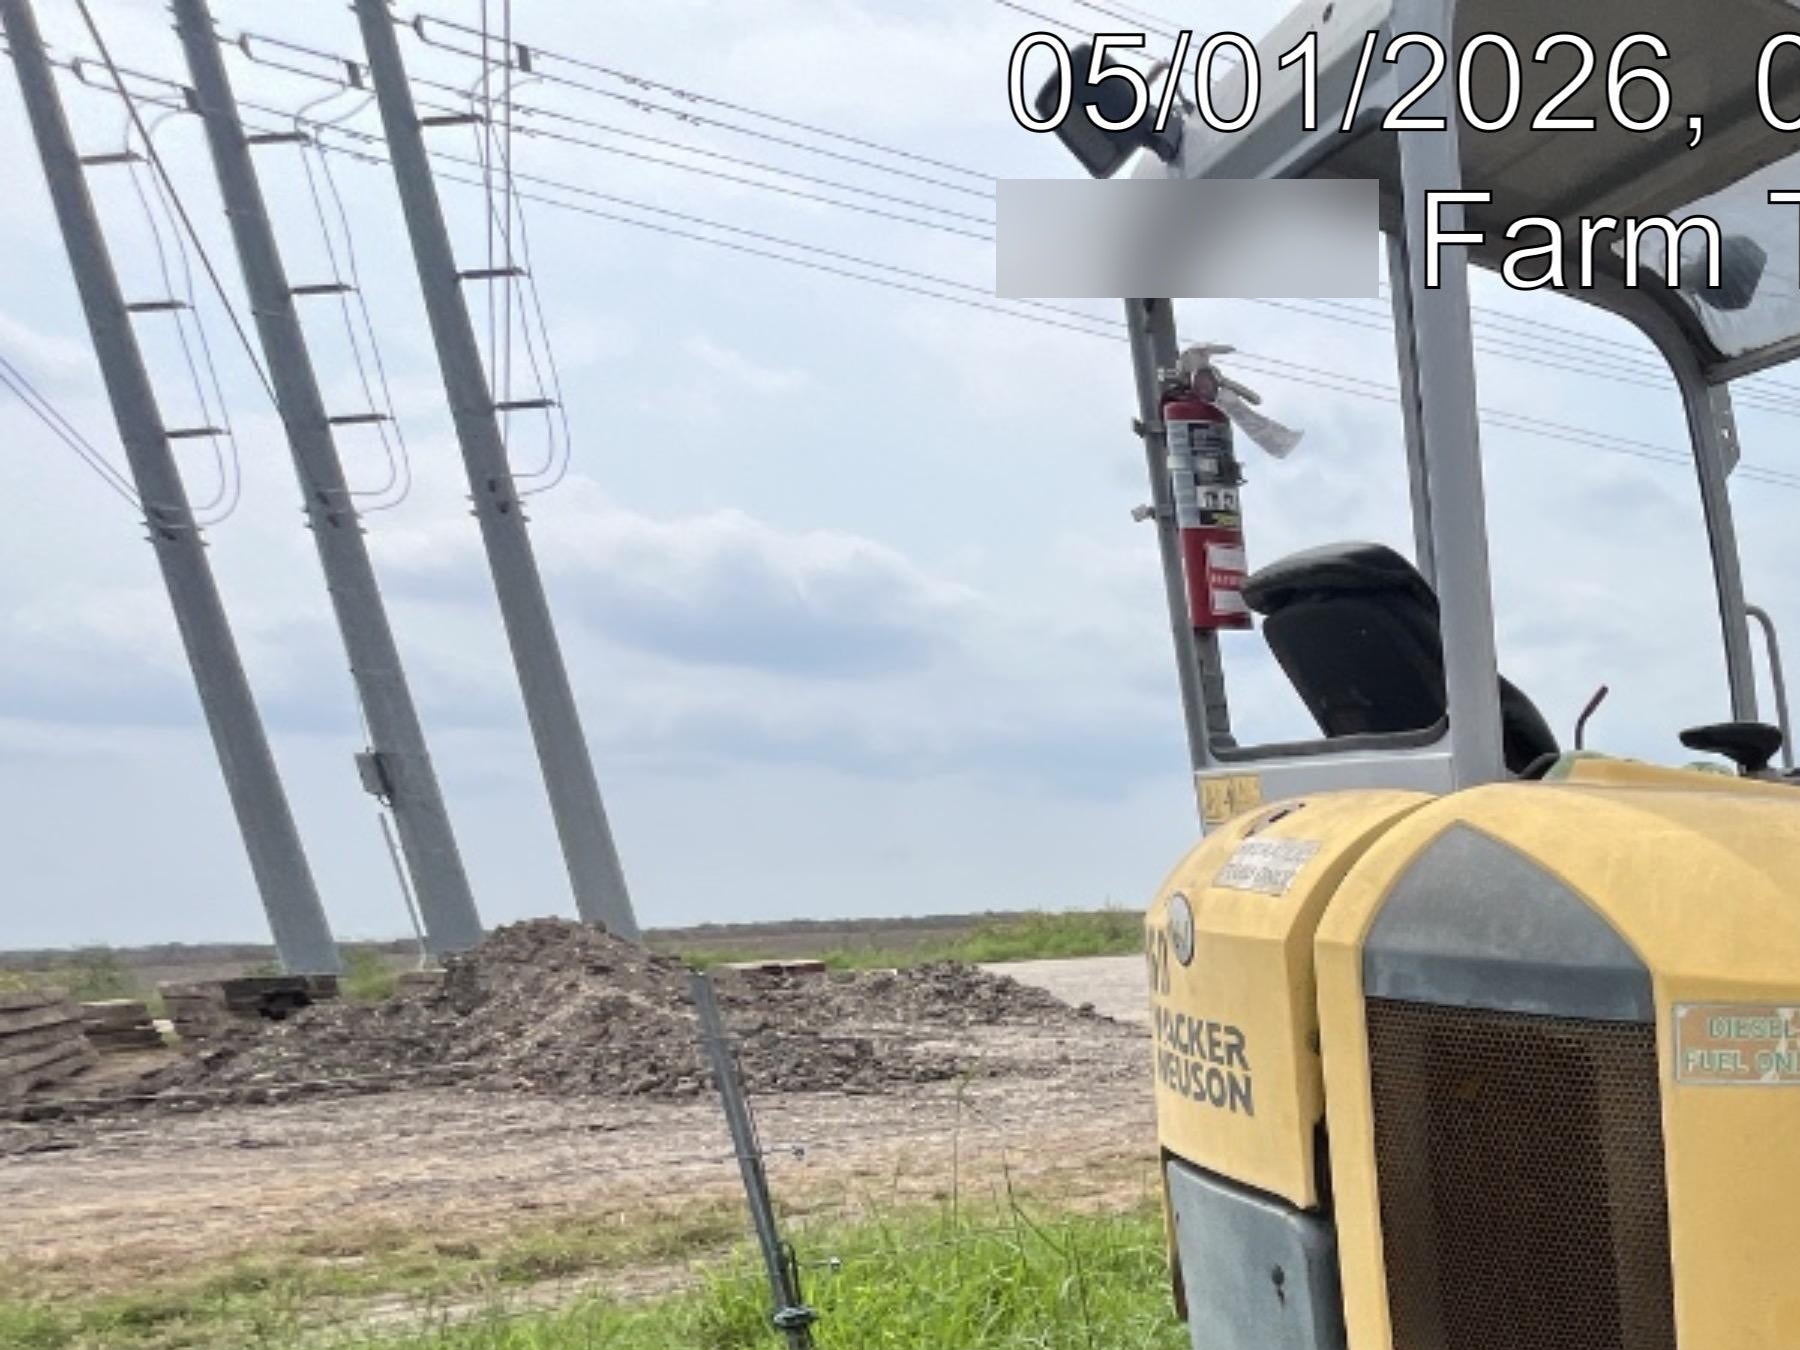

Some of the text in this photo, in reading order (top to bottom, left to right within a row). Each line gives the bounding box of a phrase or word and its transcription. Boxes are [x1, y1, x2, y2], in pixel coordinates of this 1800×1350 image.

[1708, 1015, 1797, 1039] DIESEL
[1685, 1049, 1750, 1073] FUEL
[1158, 1046, 1255, 1118] NEUSON
